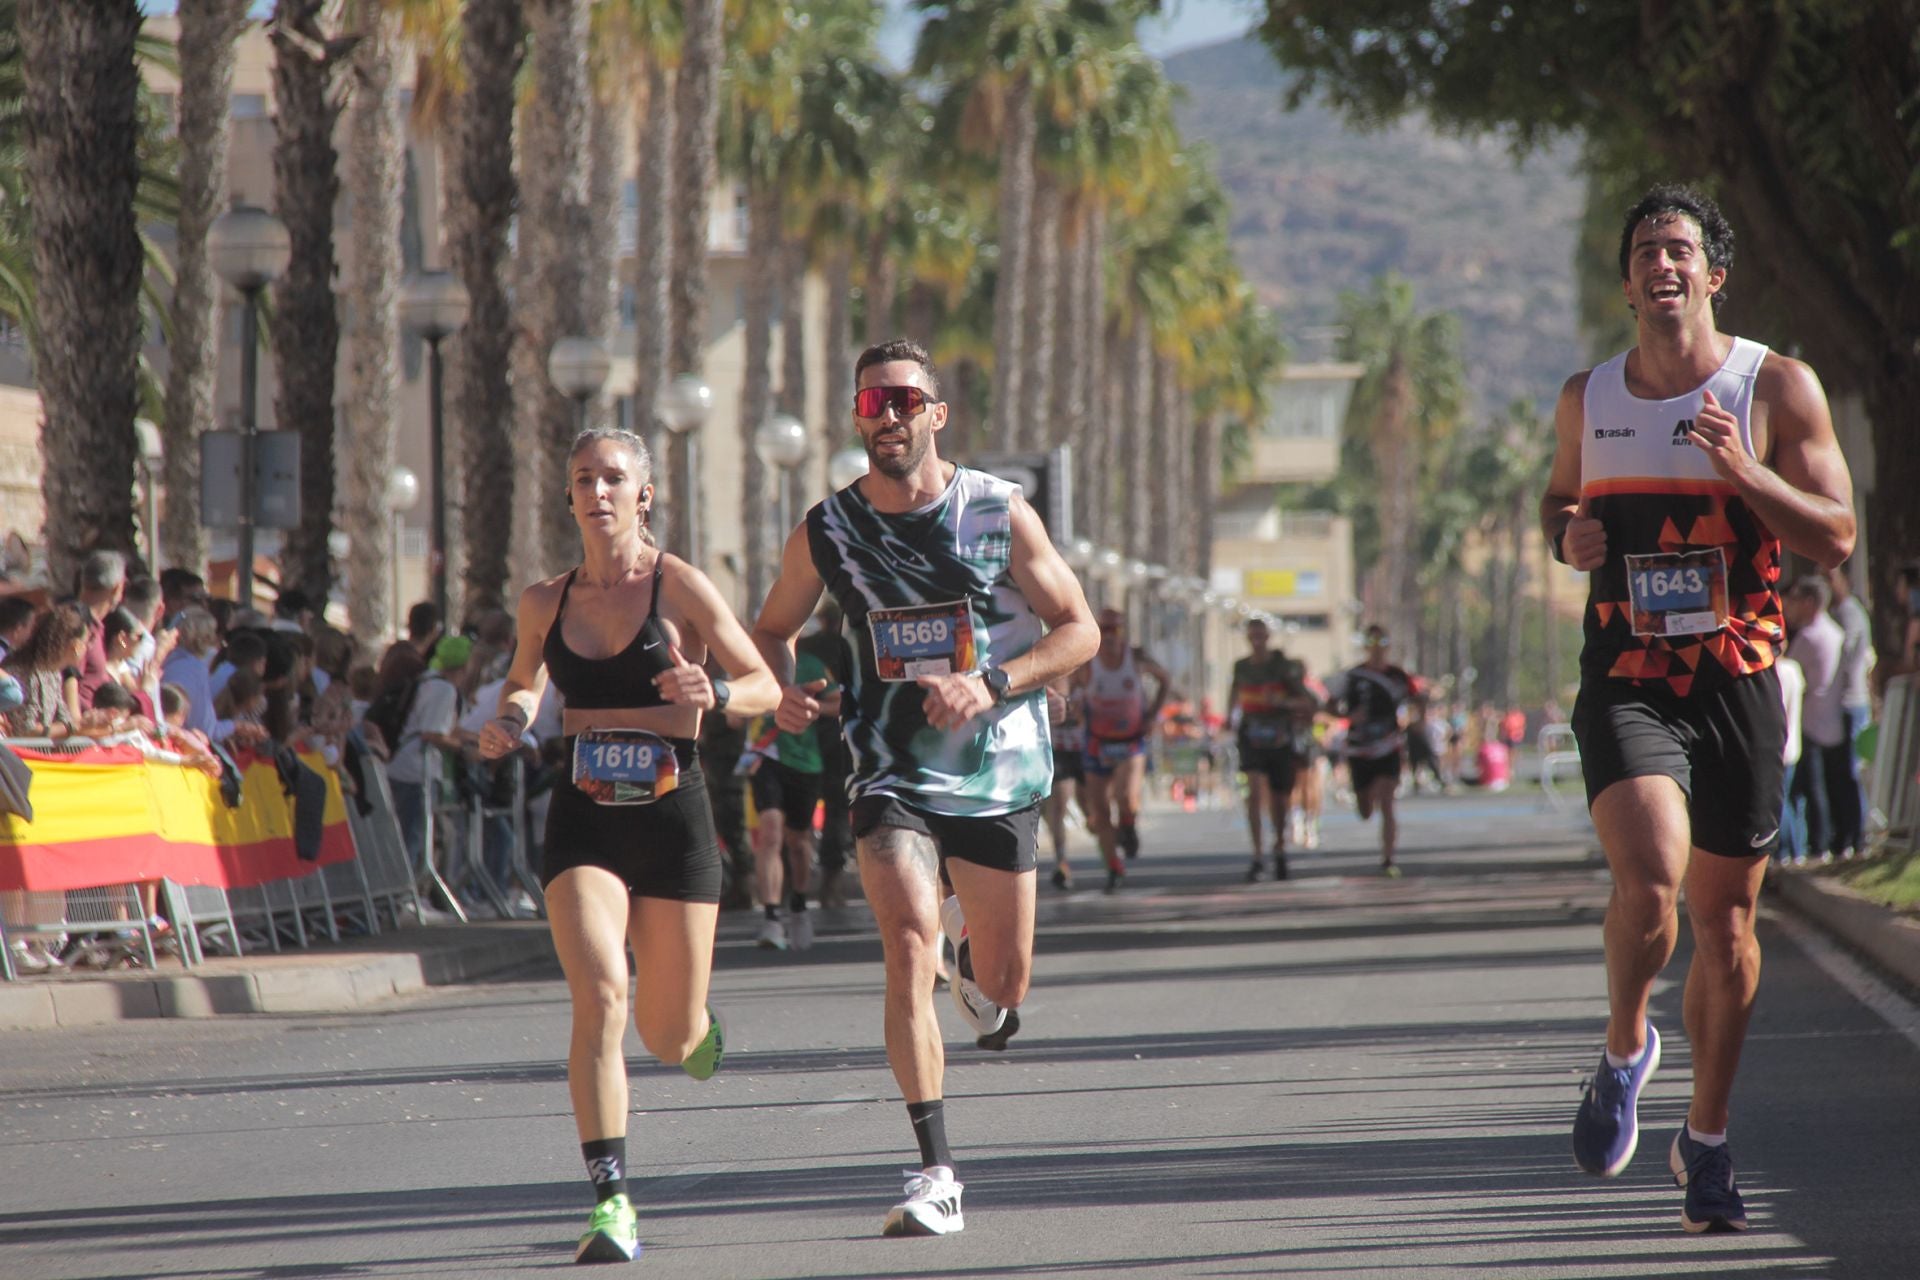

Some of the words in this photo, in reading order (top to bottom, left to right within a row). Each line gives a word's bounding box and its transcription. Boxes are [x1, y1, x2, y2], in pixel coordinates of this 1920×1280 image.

[1635, 569, 1703, 597] 1643
[888, 619, 948, 646] 1569
[592, 745, 653, 769] 1619
